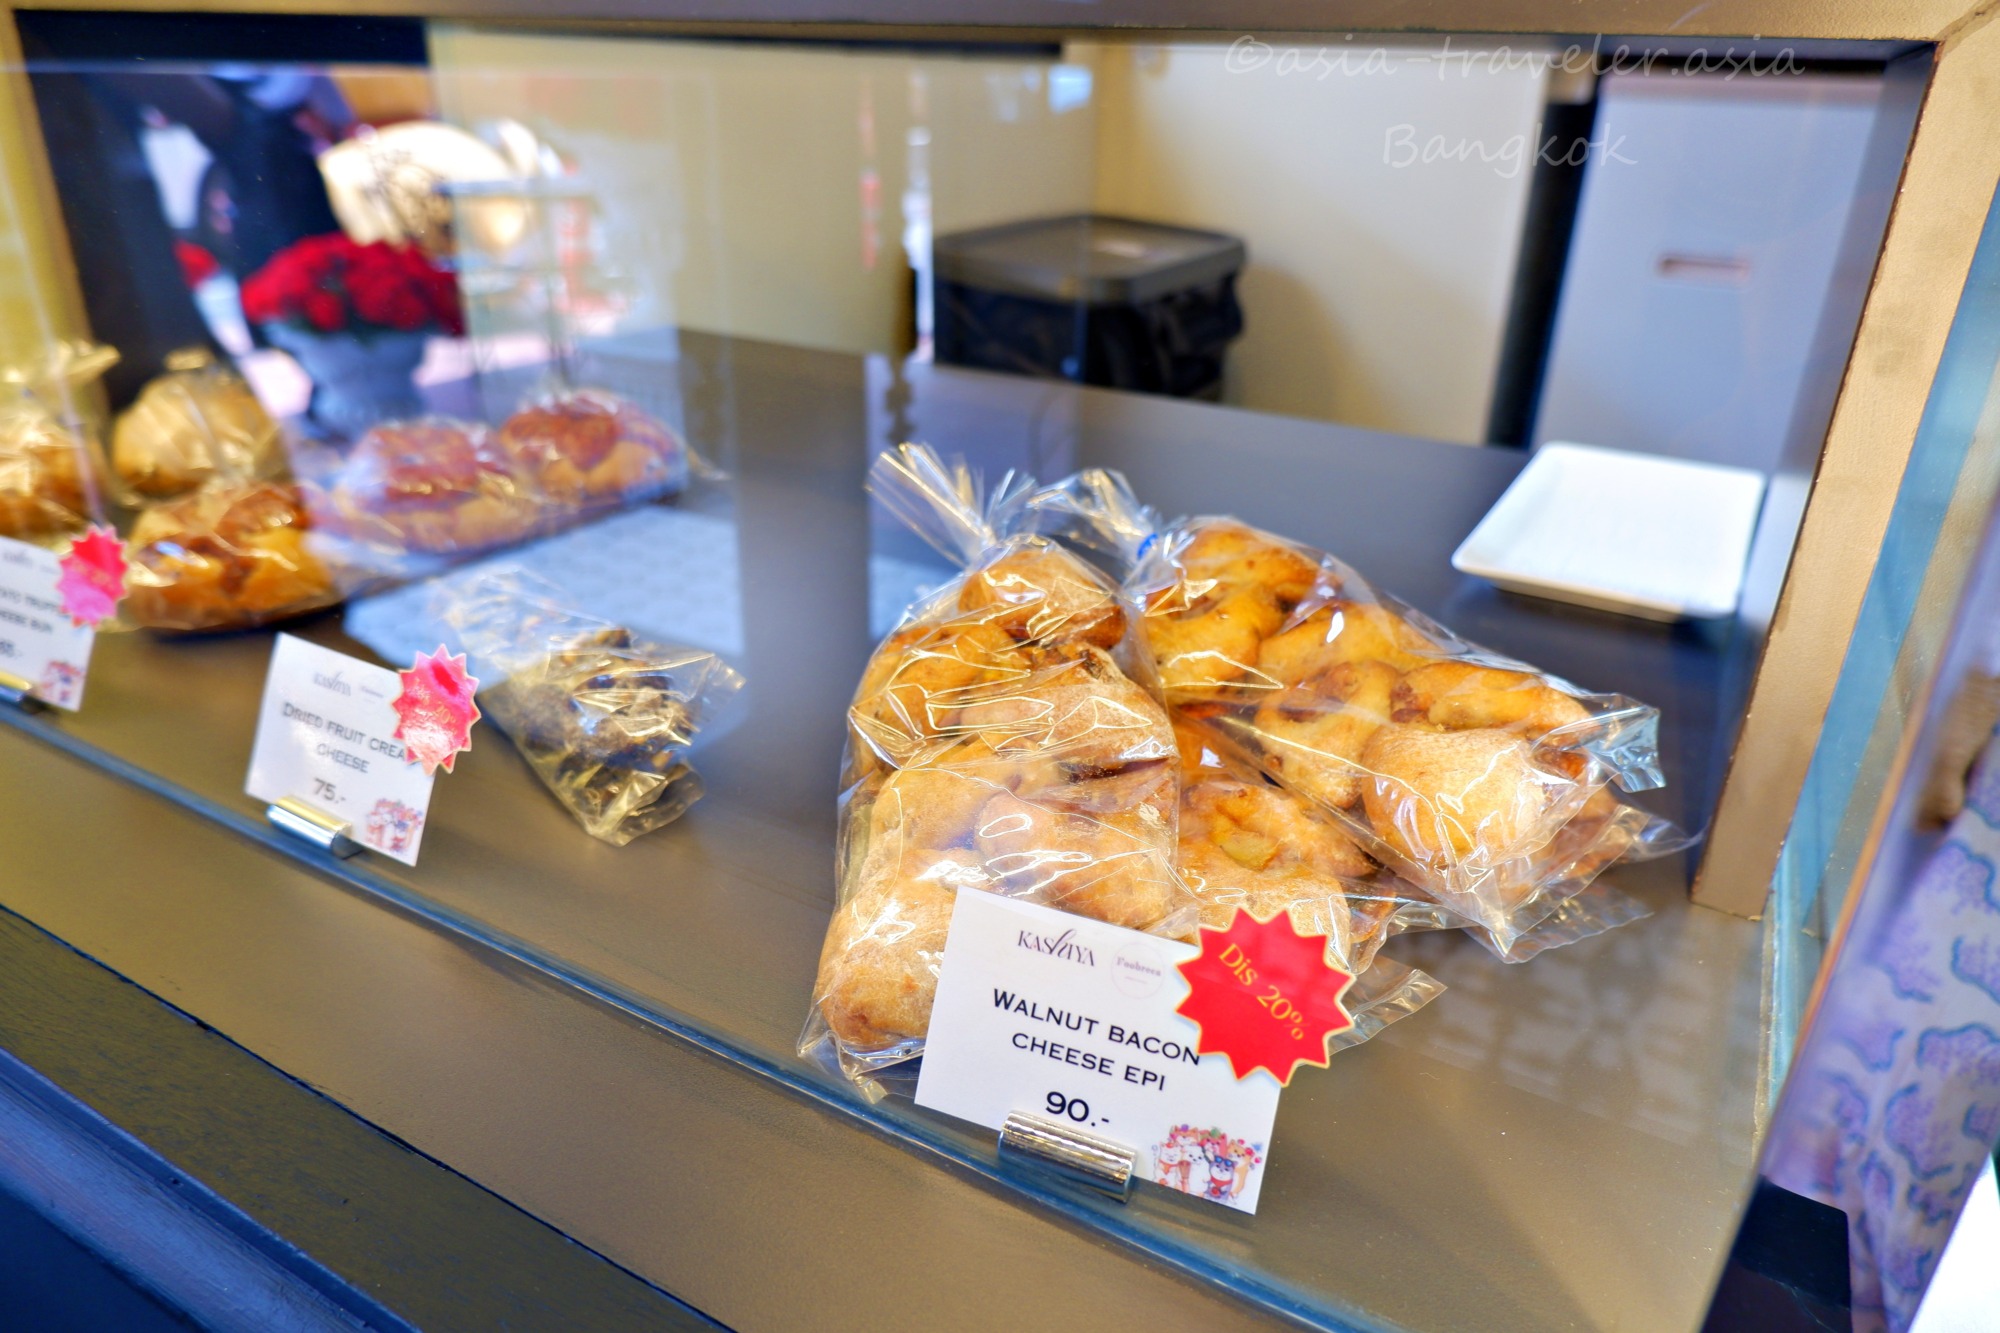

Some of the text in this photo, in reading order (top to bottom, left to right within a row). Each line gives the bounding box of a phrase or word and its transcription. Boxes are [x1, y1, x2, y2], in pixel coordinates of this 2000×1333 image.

[282, 701, 406, 761] DRIED FRUIT CREA
[316, 743, 370, 774] CHEESE
[1219, 943, 1311, 1041] Dis 20%
[993, 988, 1200, 1066] WALNUT BACON
[1012, 1032, 1166, 1091] CHEESE EPI
[1045, 1090, 1110, 1127] 90.-
